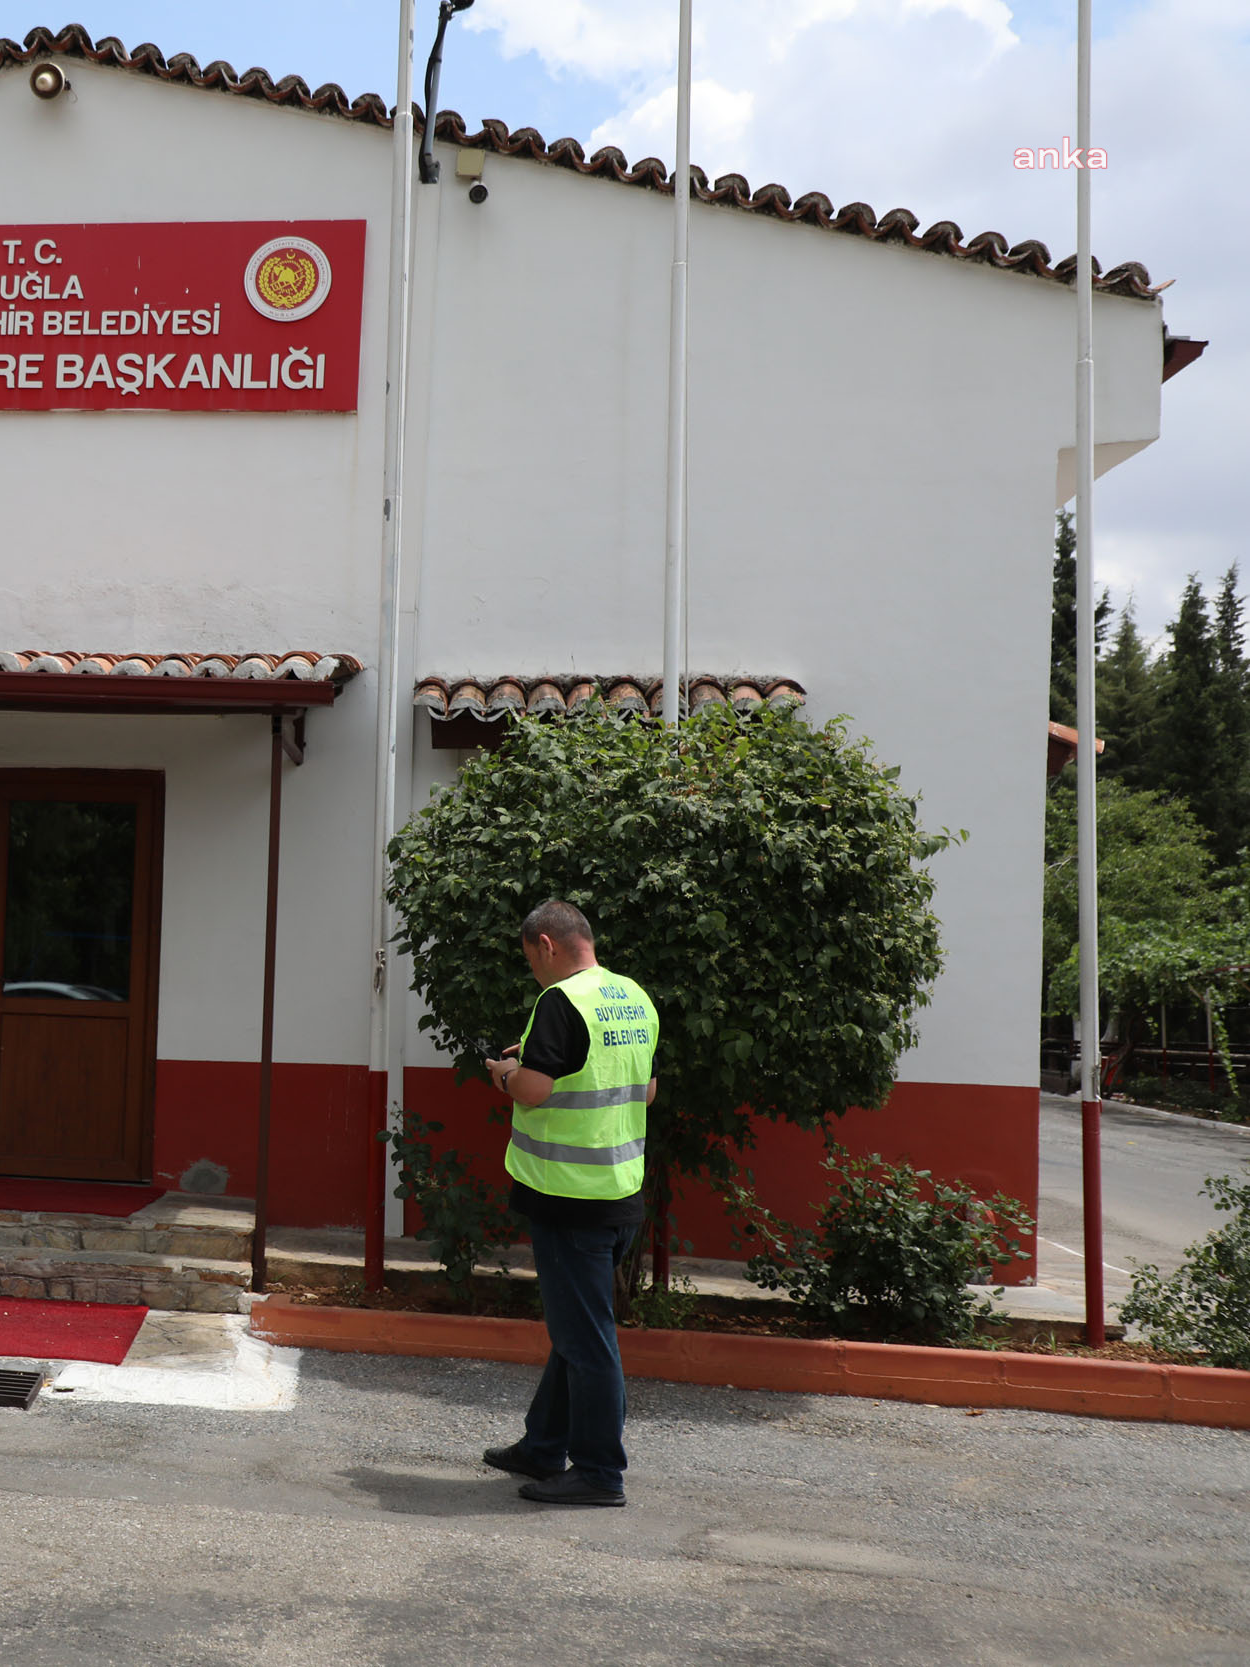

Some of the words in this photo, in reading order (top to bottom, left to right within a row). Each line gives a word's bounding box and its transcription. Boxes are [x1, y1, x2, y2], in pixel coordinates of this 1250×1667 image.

[42, 303, 220, 336] BELEDİYESİ
[55, 346, 326, 395] BAŞKANLIĞI
[598, 983, 629, 1000] MUĞLA
[595, 1003, 648, 1024] BÜYÜKŞEHİR
[603, 1026, 650, 1046] BELEDİYESİ
